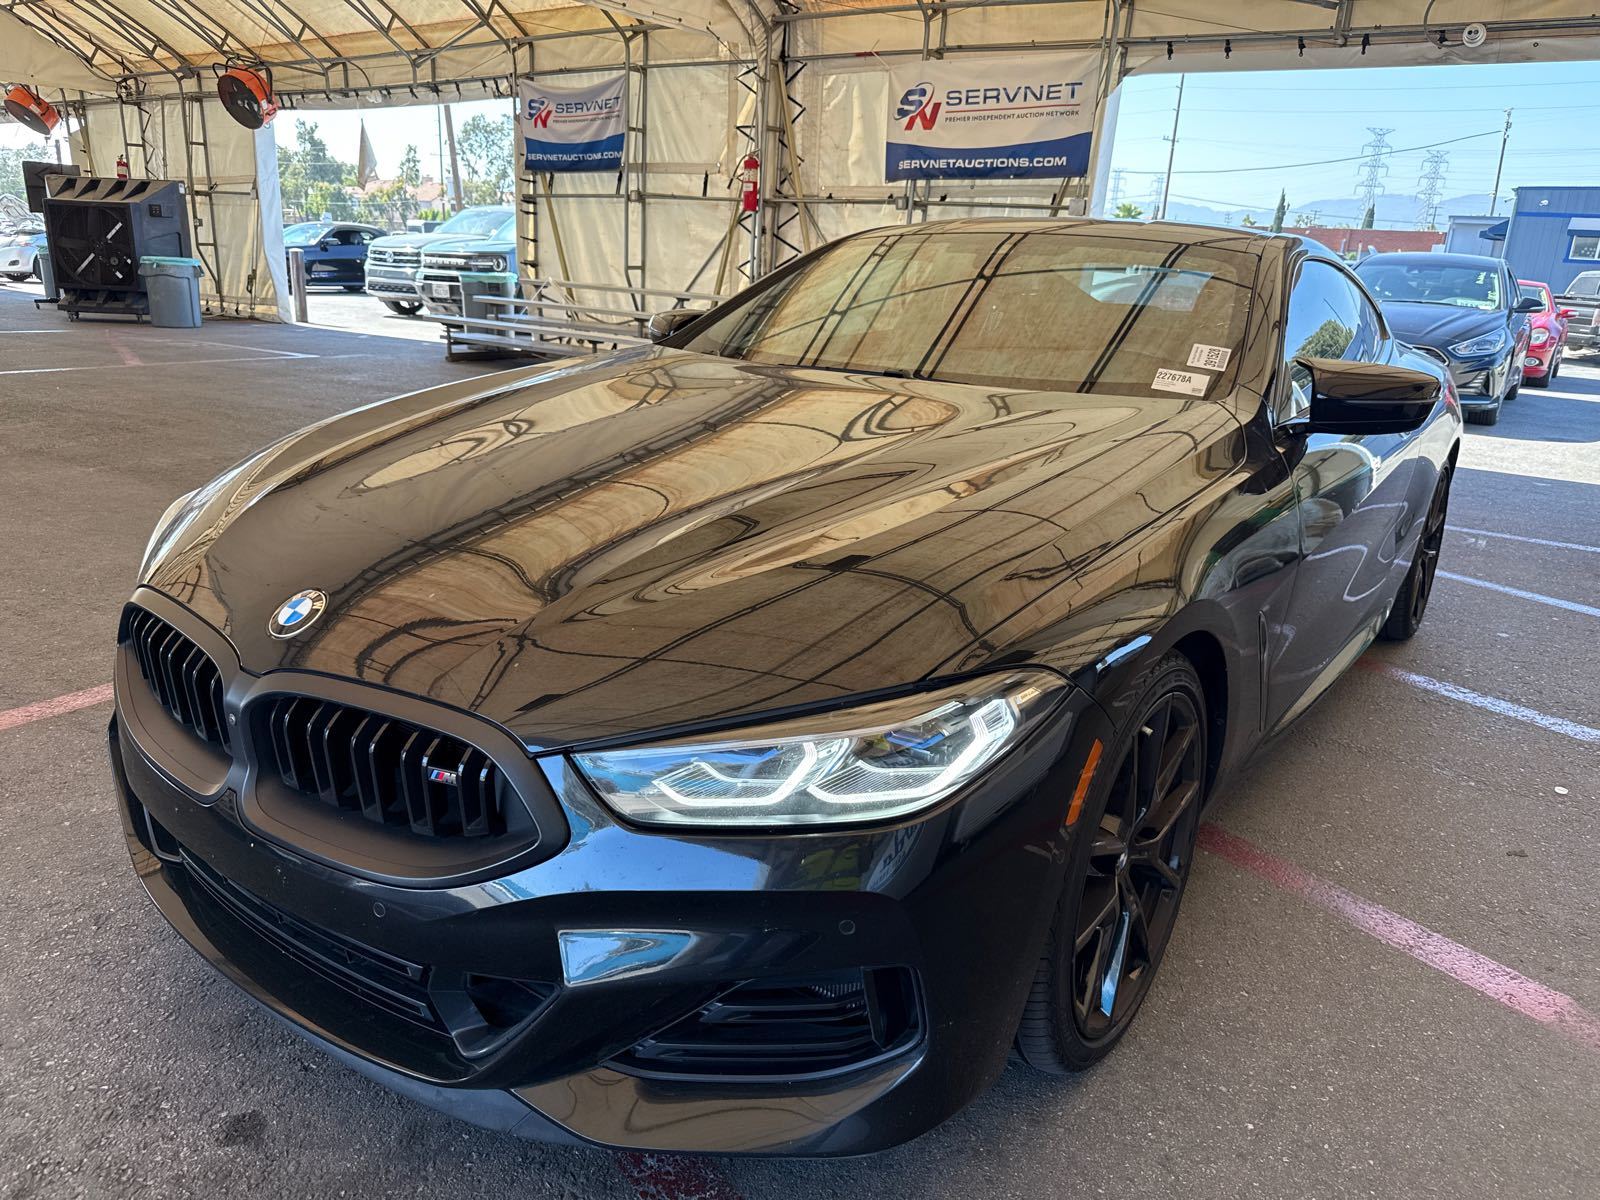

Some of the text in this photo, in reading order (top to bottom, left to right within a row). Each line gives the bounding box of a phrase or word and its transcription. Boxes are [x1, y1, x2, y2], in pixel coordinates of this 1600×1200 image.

[945, 82, 1083, 106] SERVNET
[555, 97, 620, 113] SERVNET
[971, 113, 1015, 121] INDEPENDENT
[1016, 111, 1045, 119] AUCTION
[898, 157, 1066, 169] SERVNETAUCTIONS.COM
[1156, 371, 1192, 383] 227678A
